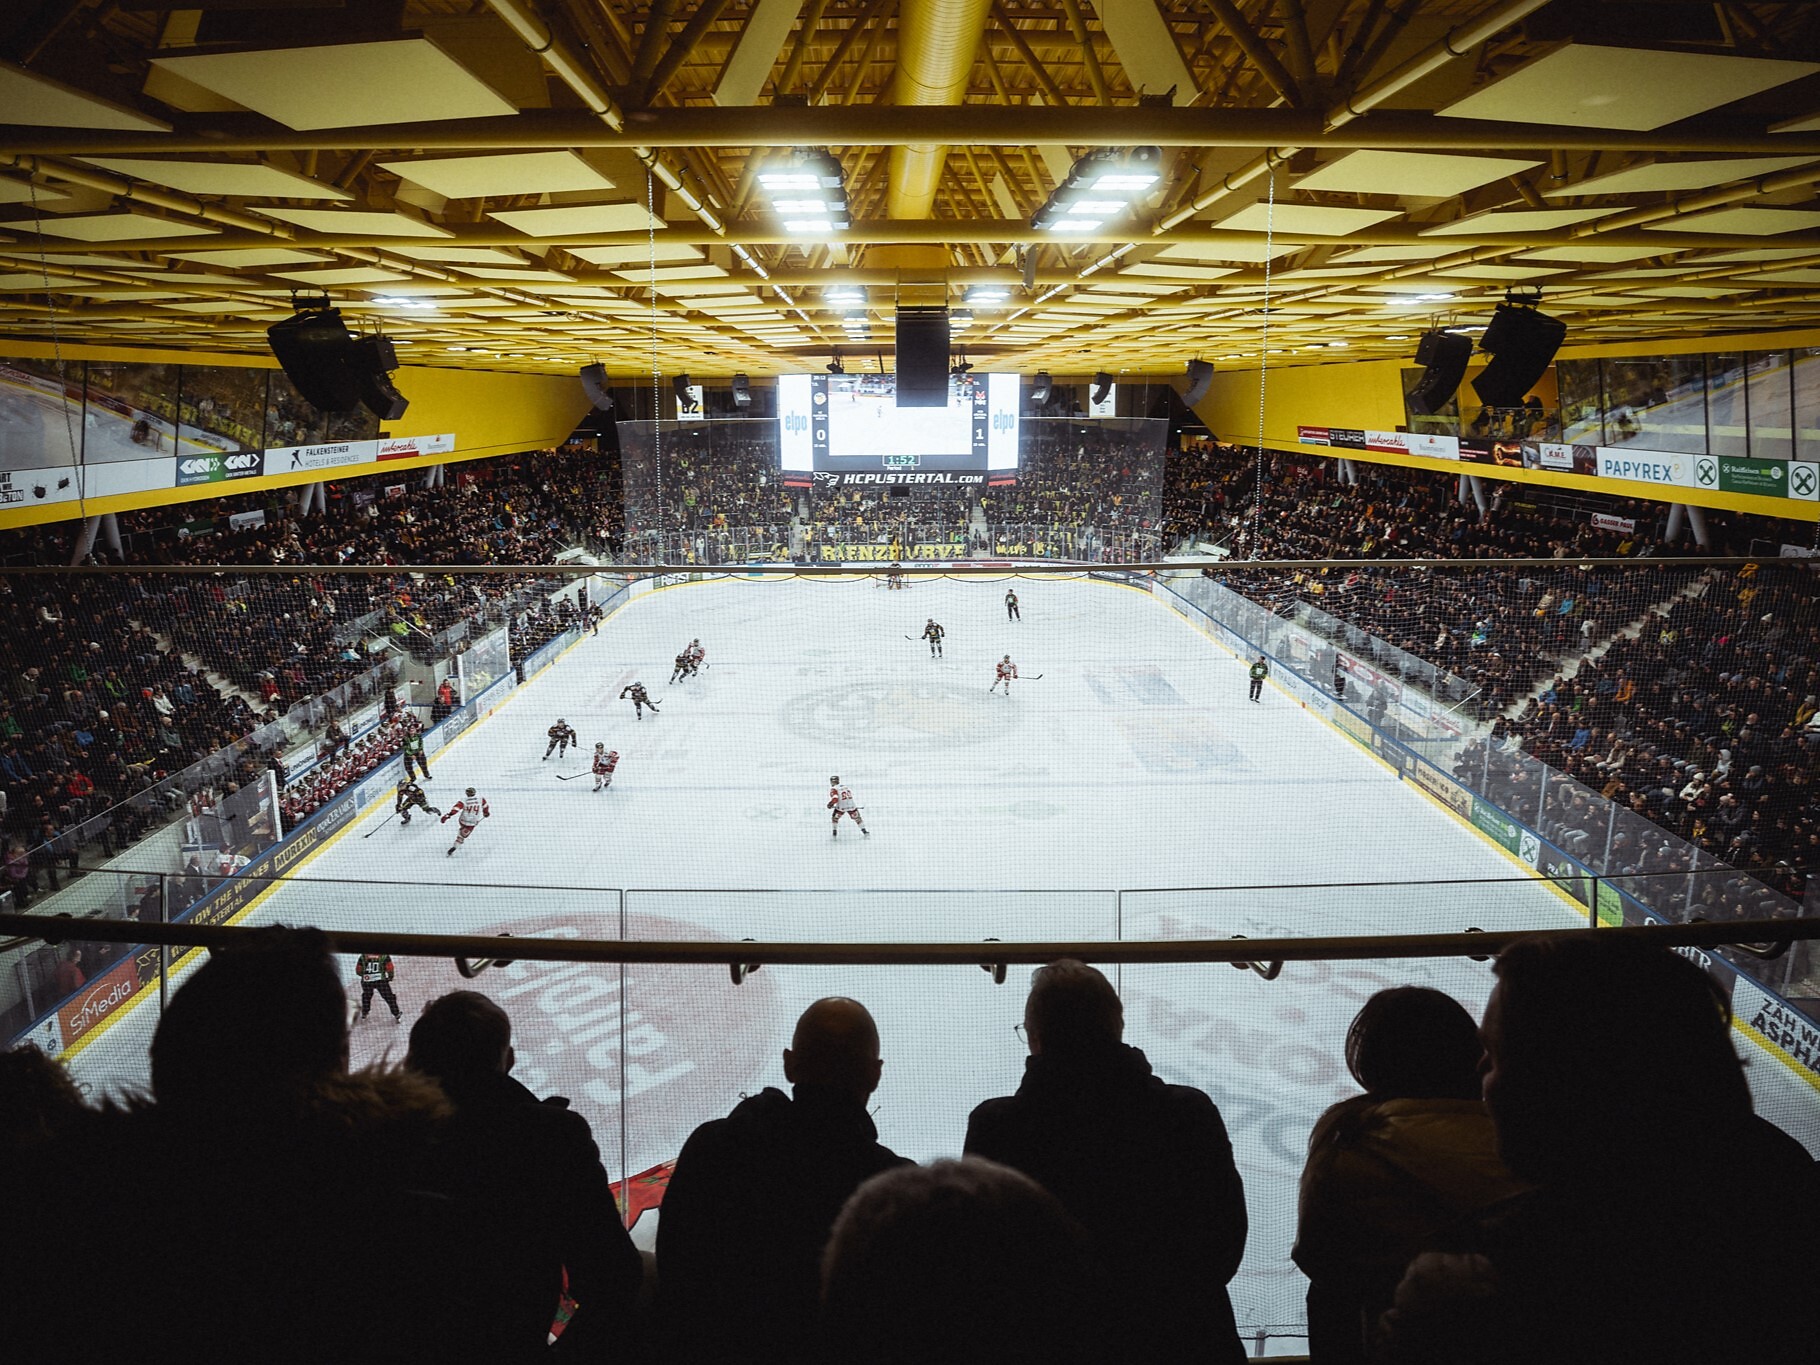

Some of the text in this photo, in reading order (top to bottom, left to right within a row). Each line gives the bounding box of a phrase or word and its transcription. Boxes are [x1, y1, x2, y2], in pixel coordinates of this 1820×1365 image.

[785, 410, 807, 436] elpo
[993, 409, 1015, 435] elpo
[816, 429, 826, 441] 0
[975, 428, 984, 440] 1
[305, 445, 349, 457] FALKENSTEINER
[305, 457, 327, 468] HOTELS
[888, 455, 915, 465] 1:52
[843, 472, 984, 485] HCPUSTERTAL.COM
[1605, 459, 1673, 482] PAPYREX
[275, 829, 317, 871] MUREXIN
[214, 888, 233, 910] THE
[365, 961, 380, 974] 40
[70, 980, 132, 1036] SiMedia
[1761, 998, 1796, 1032] ZÄH
